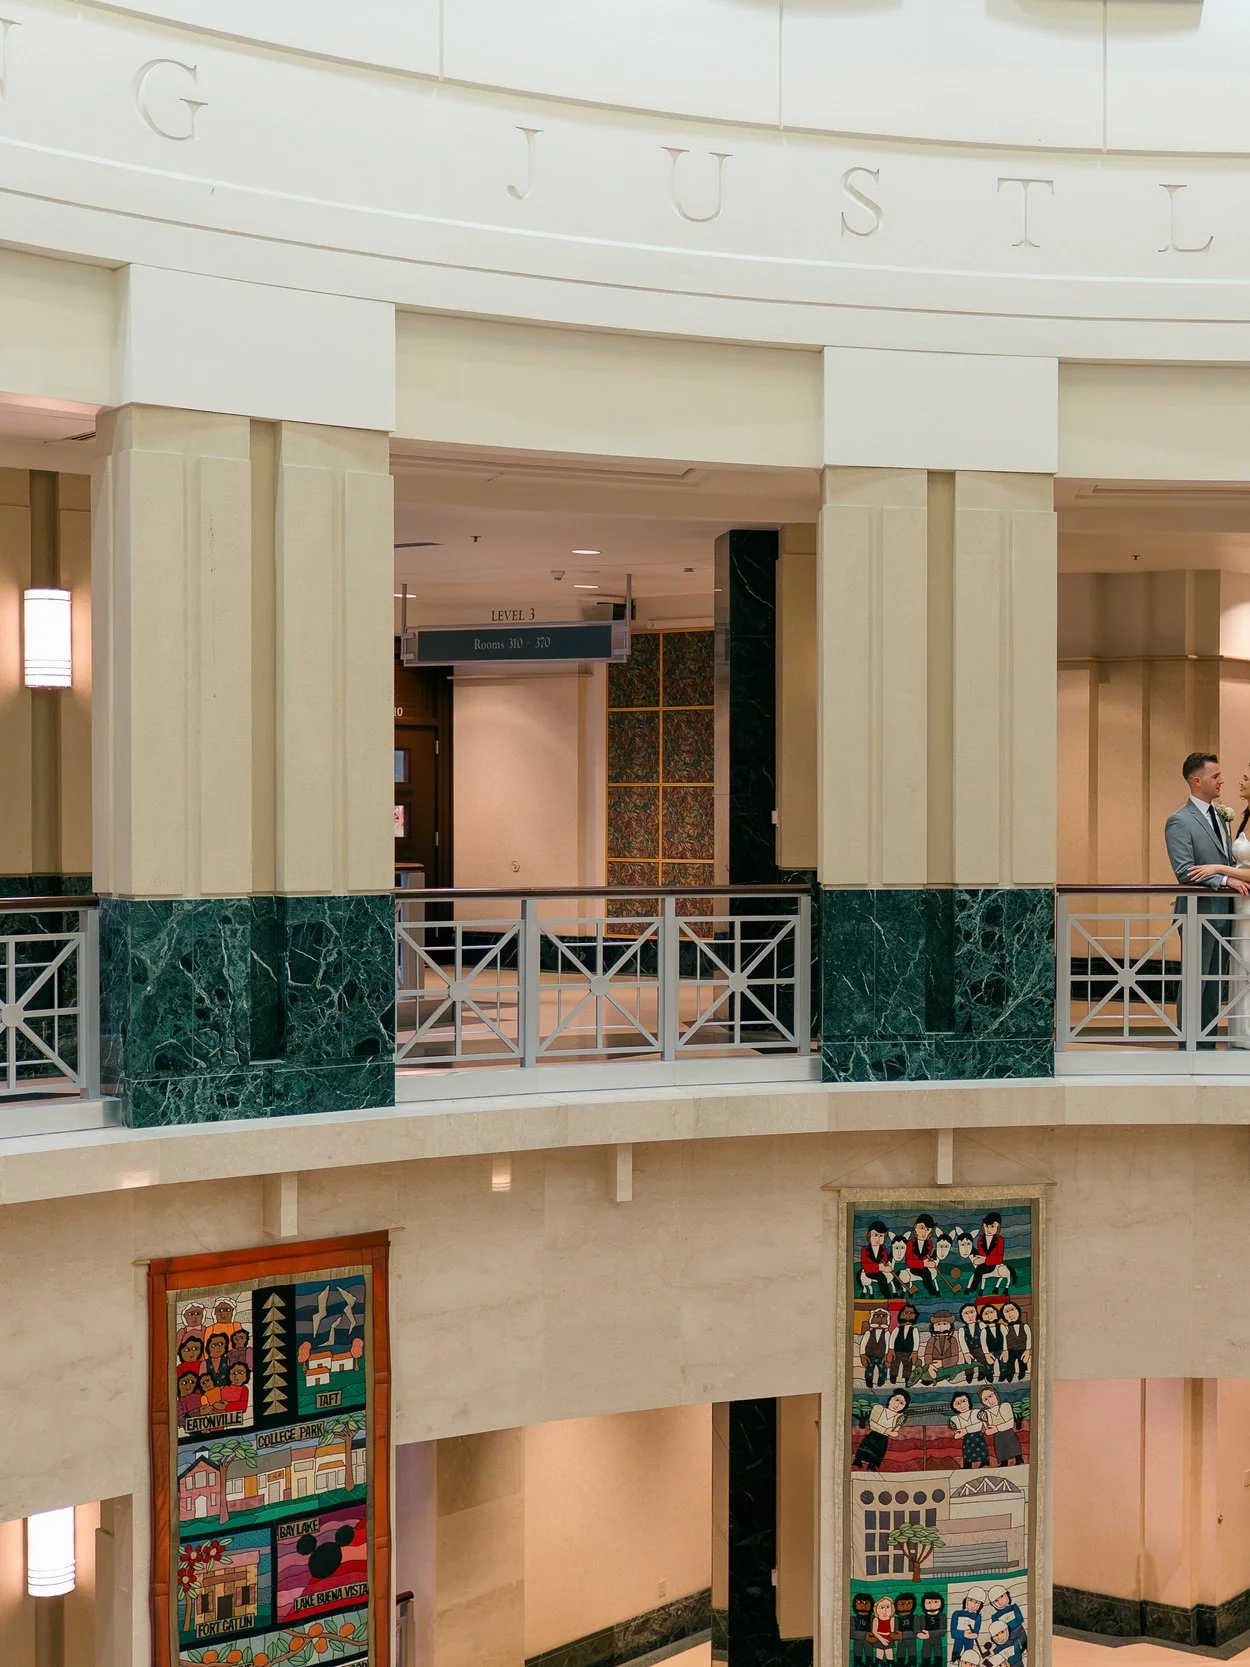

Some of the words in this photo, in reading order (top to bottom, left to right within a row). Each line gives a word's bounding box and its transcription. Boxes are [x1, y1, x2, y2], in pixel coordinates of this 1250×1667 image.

[491, 609, 524, 622] LEVEL
[528, 607, 535, 621] 3
[474, 638, 505, 650] Rooms
[508, 637, 522, 649] 310
[535, 636, 551, 648] 370
[317, 1392, 340, 1406] TAFT
[187, 1411, 242, 1431] EATONVILLE
[258, 1428, 296, 1447] COLLEGE
[300, 1423, 323, 1439] PARK
[280, 1524, 295, 1538] BAY
[296, 1519, 319, 1535] LAKE
[295, 1594, 315, 1611] LAKE
[316, 1587, 343, 1604] BUENA
[344, 1583, 369, 1598] VISTA
[198, 1622, 220, 1638] FORT
[222, 1615, 253, 1632] GATLIN
